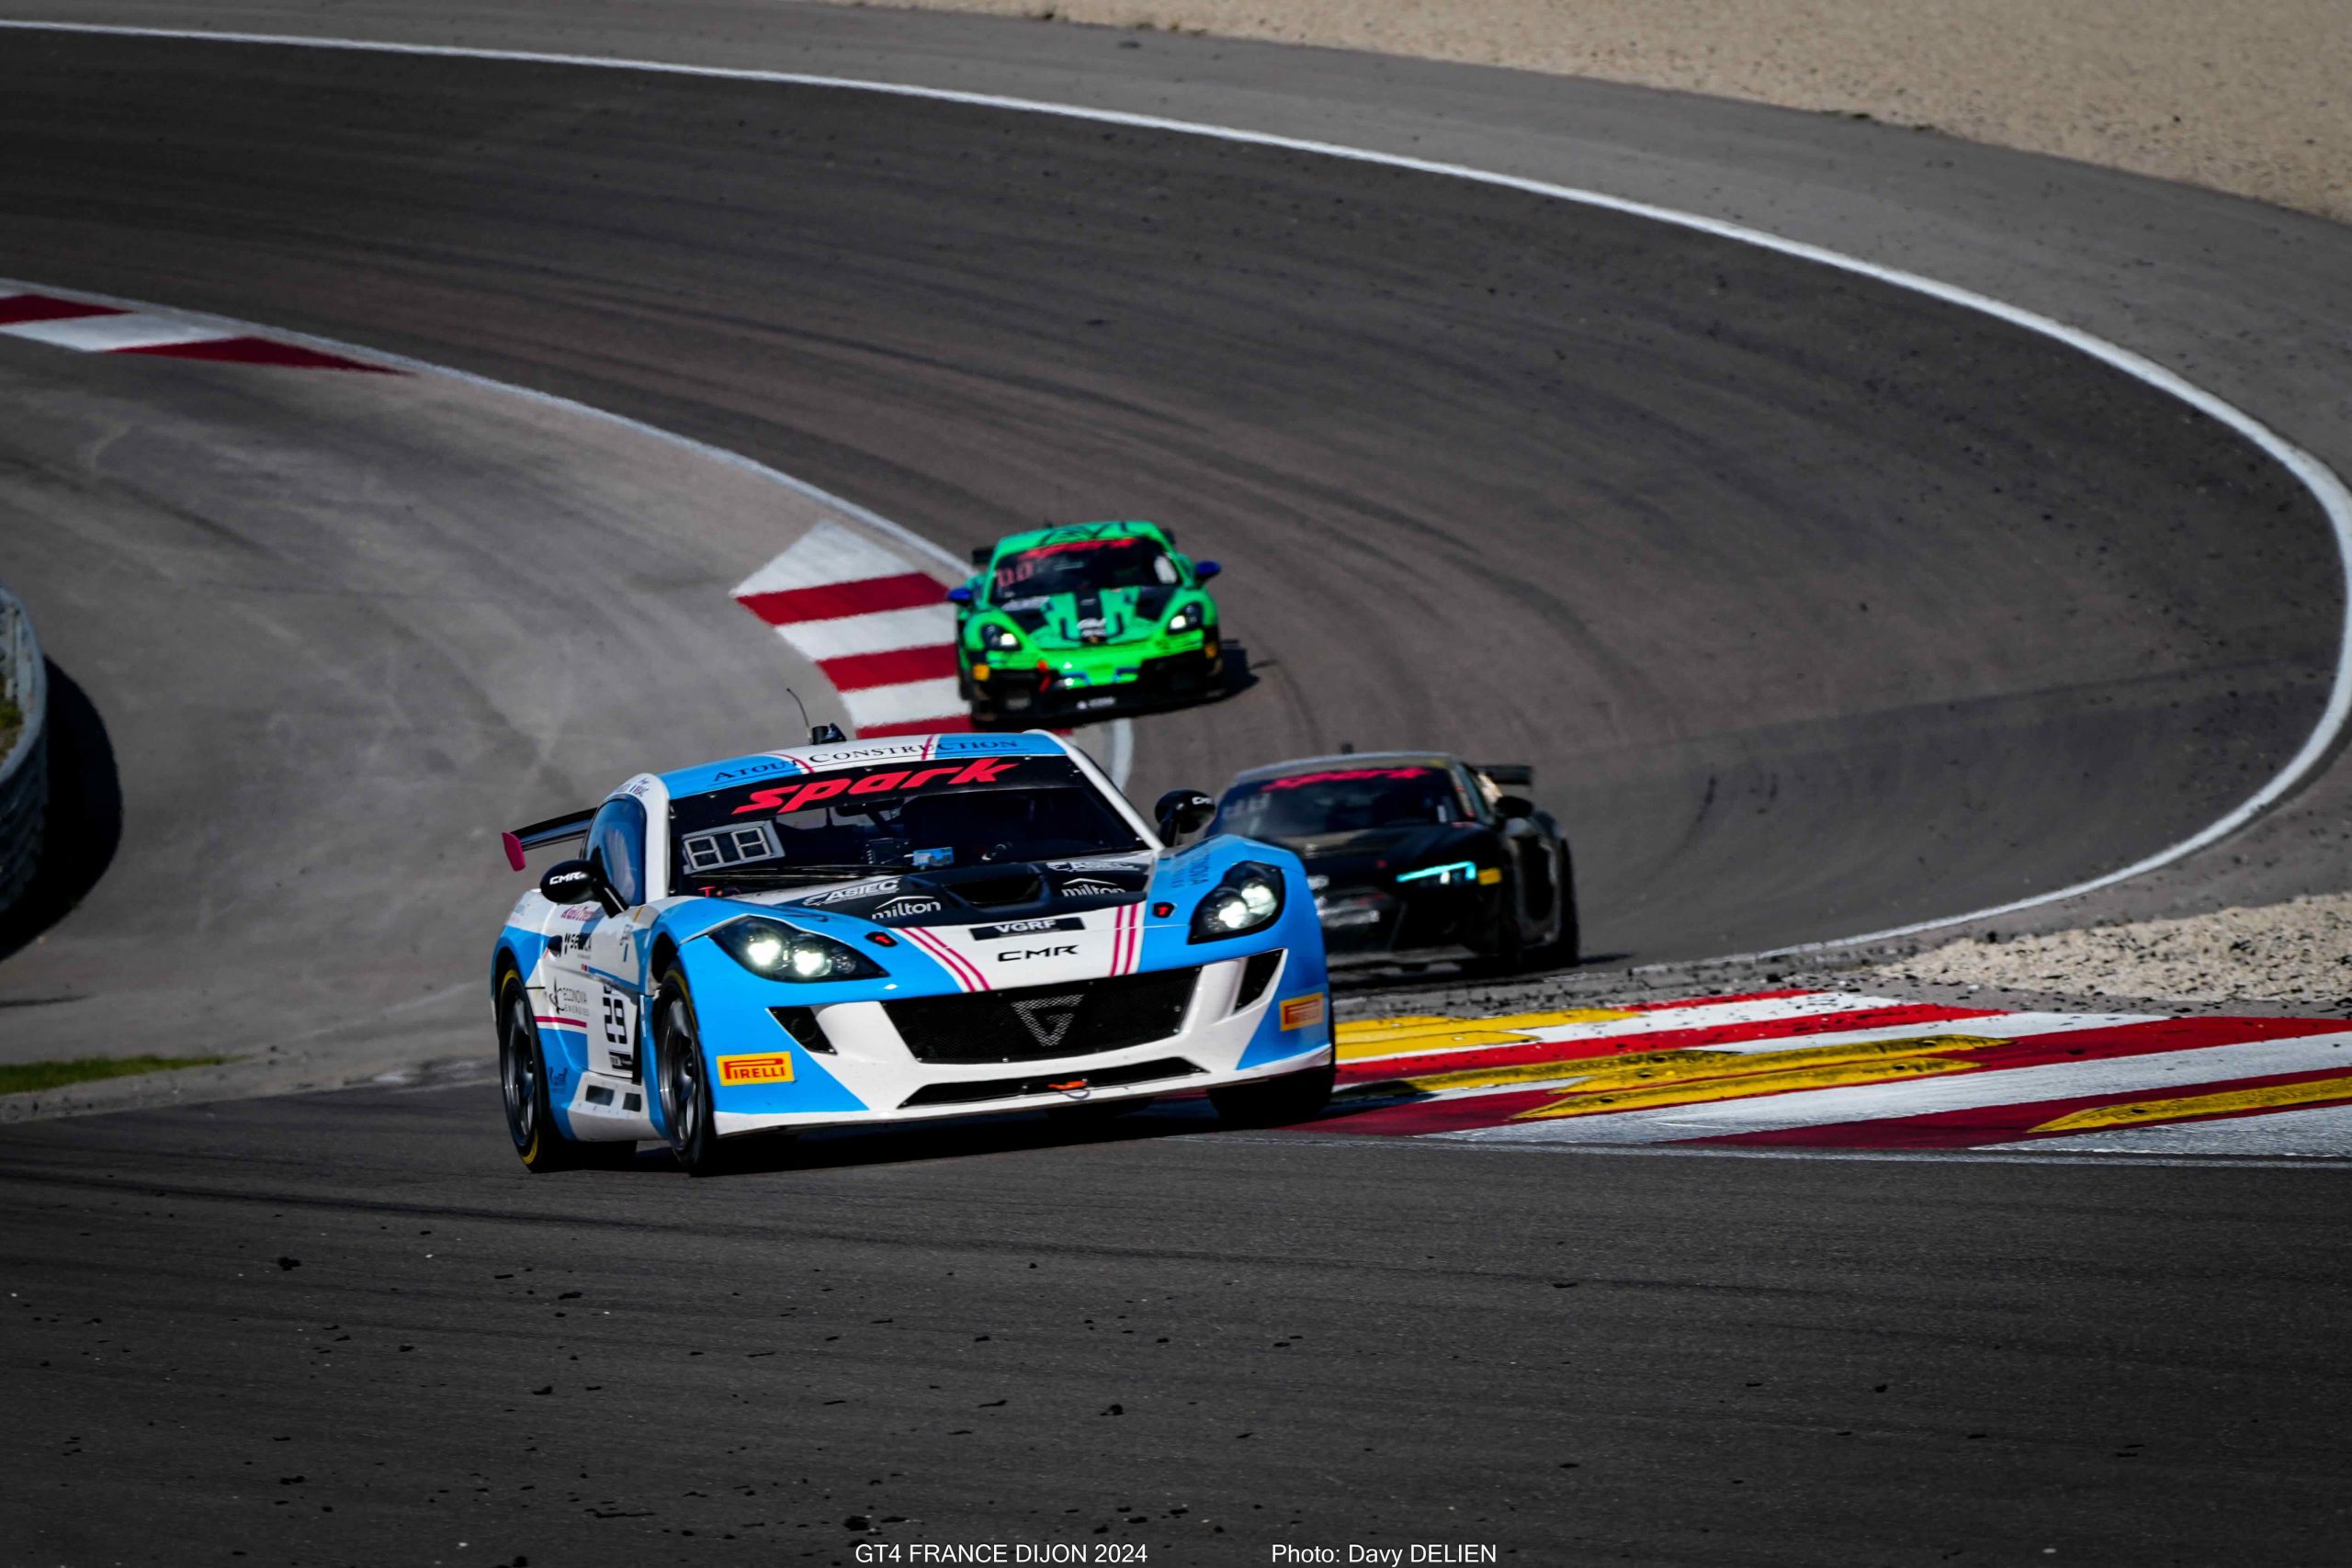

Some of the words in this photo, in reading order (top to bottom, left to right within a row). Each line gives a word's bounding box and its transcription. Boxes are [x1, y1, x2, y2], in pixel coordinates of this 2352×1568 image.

[713, 759, 800, 781] ATOUT
[809, 739, 1018, 763] CONSTRUCTION
[731, 757, 1021, 815] spark
[549, 872, 583, 886] CMR
[871, 900, 942, 920] milton
[994, 919, 1057, 933] VGRF
[998, 944, 1080, 963] CMR
[603, 997, 628, 1044] 29
[722, 1057, 786, 1080] PIRELLI
